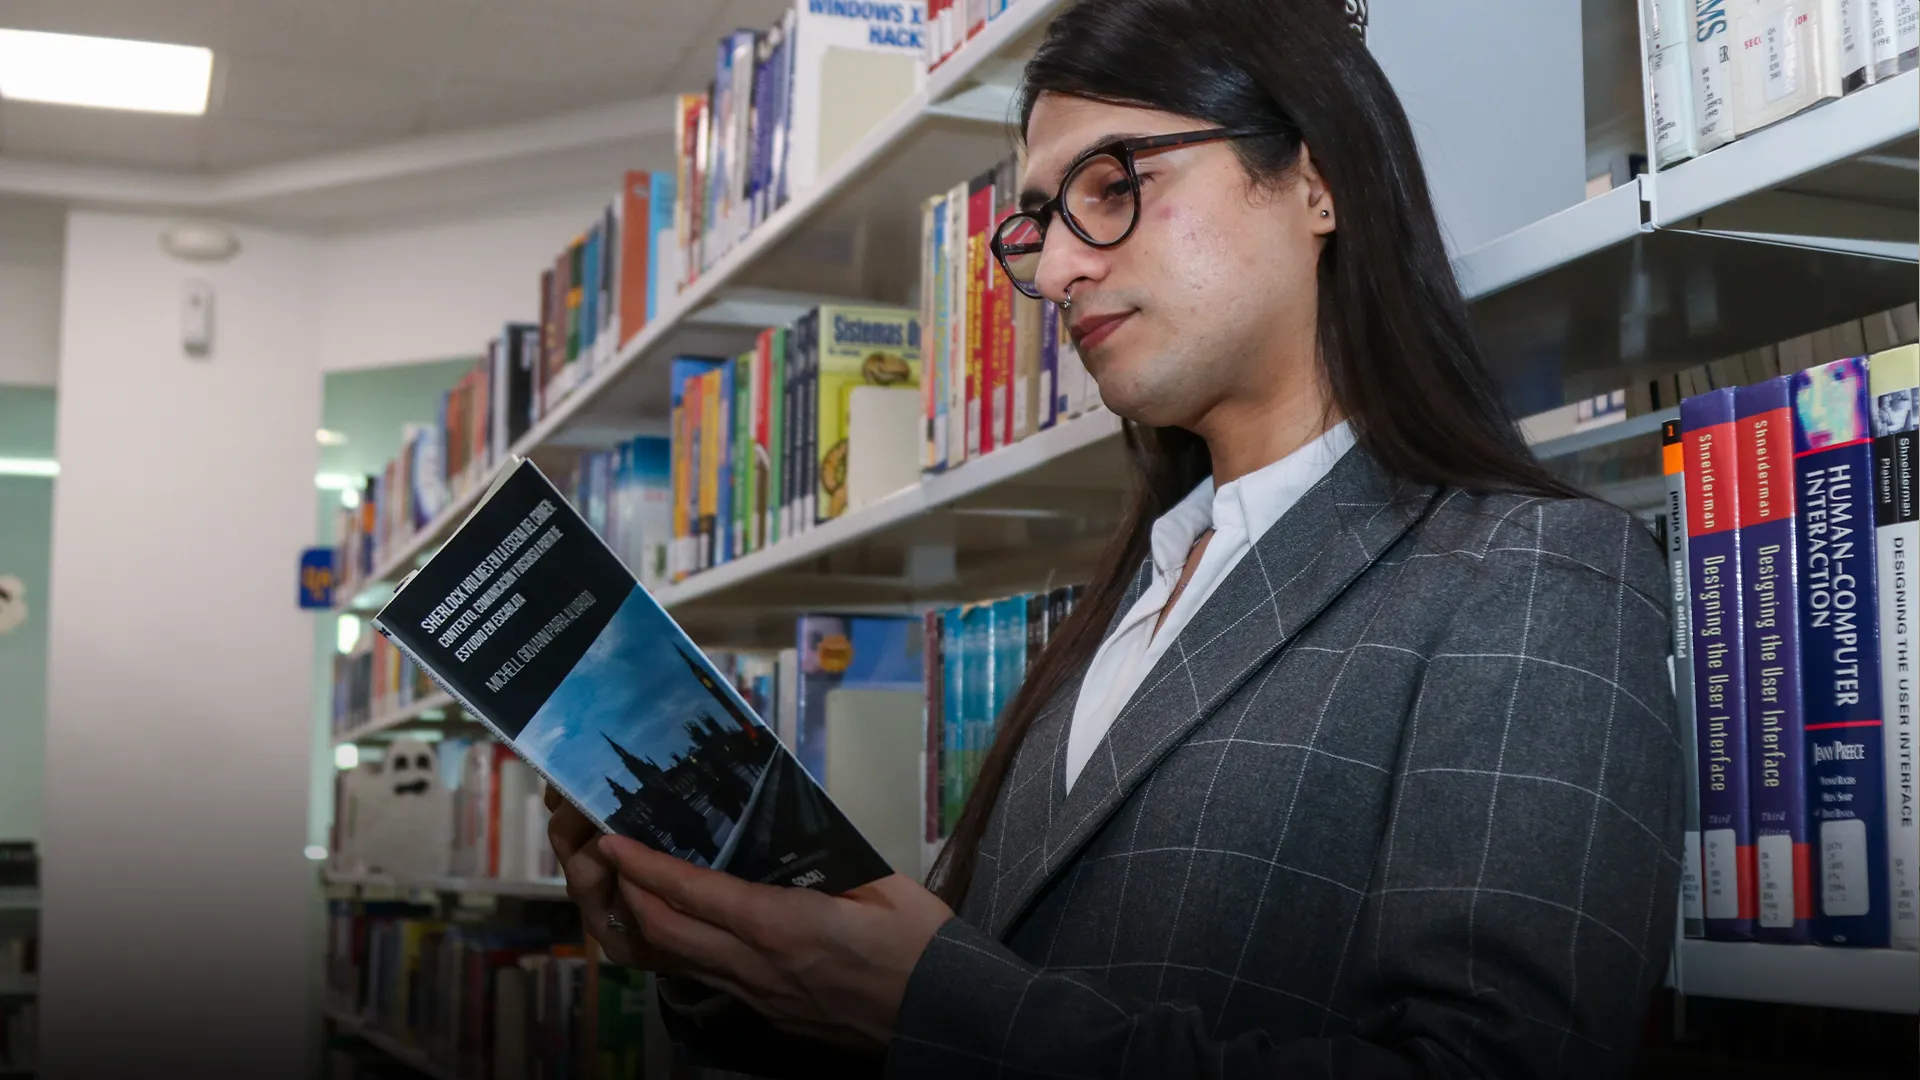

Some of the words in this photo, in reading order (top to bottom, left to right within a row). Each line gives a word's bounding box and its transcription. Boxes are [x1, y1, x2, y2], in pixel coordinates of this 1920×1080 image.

[809, 0, 904, 22] WINDOWS
[1696, 0, 1727, 42] MS
[834, 313, 903, 346] Sistemas
[1699, 433, 1715, 529] Shneiderman
[1754, 419, 1772, 517] Shneiderman
[1880, 457, 1891, 504] Plaisant
[1900, 437, 1911, 517] Shneiderman
[520, 516, 537, 534] DEL
[1671, 491, 1680, 532] virtual
[486, 552, 502, 569] EN
[494, 545, 509, 560] LA
[501, 526, 528, 553] ESCENA
[1673, 536, 1681, 552] Lo
[1806, 469, 1831, 628] INTERACTION
[460, 560, 494, 593] HOLMES
[1674, 560, 1686, 602] Quéau
[1701, 555, 1726, 637] Designing
[1754, 544, 1780, 628] Designing
[1828, 464, 1859, 707] HUMAN-COMPUTER
[1893, 536, 1909, 638] DESIGNING
[420, 587, 468, 634] SHERLOCK
[438, 607, 480, 647] CONTEXTO,
[473, 568, 516, 613] COMUNICACIÓN
[510, 567, 520, 576] Y
[455, 629, 488, 661] ESTUDIO
[482, 620, 497, 634] EN
[491, 592, 525, 626] ESCARLATA
[485, 655, 524, 692] MICHELL
[545, 612, 570, 636] PARRA
[1676, 605, 1688, 659] Philippe
[1707, 642, 1728, 668] the
[1759, 635, 1783, 661] the
[1896, 640, 1910, 673] THE
[1708, 674, 1730, 709] User
[1761, 667, 1784, 703] User
[1897, 679, 1911, 727] USER
[1709, 716, 1732, 791] Interface
[1762, 709, 1786, 788] Interface
[1900, 732, 1913, 828] INTERFACE
